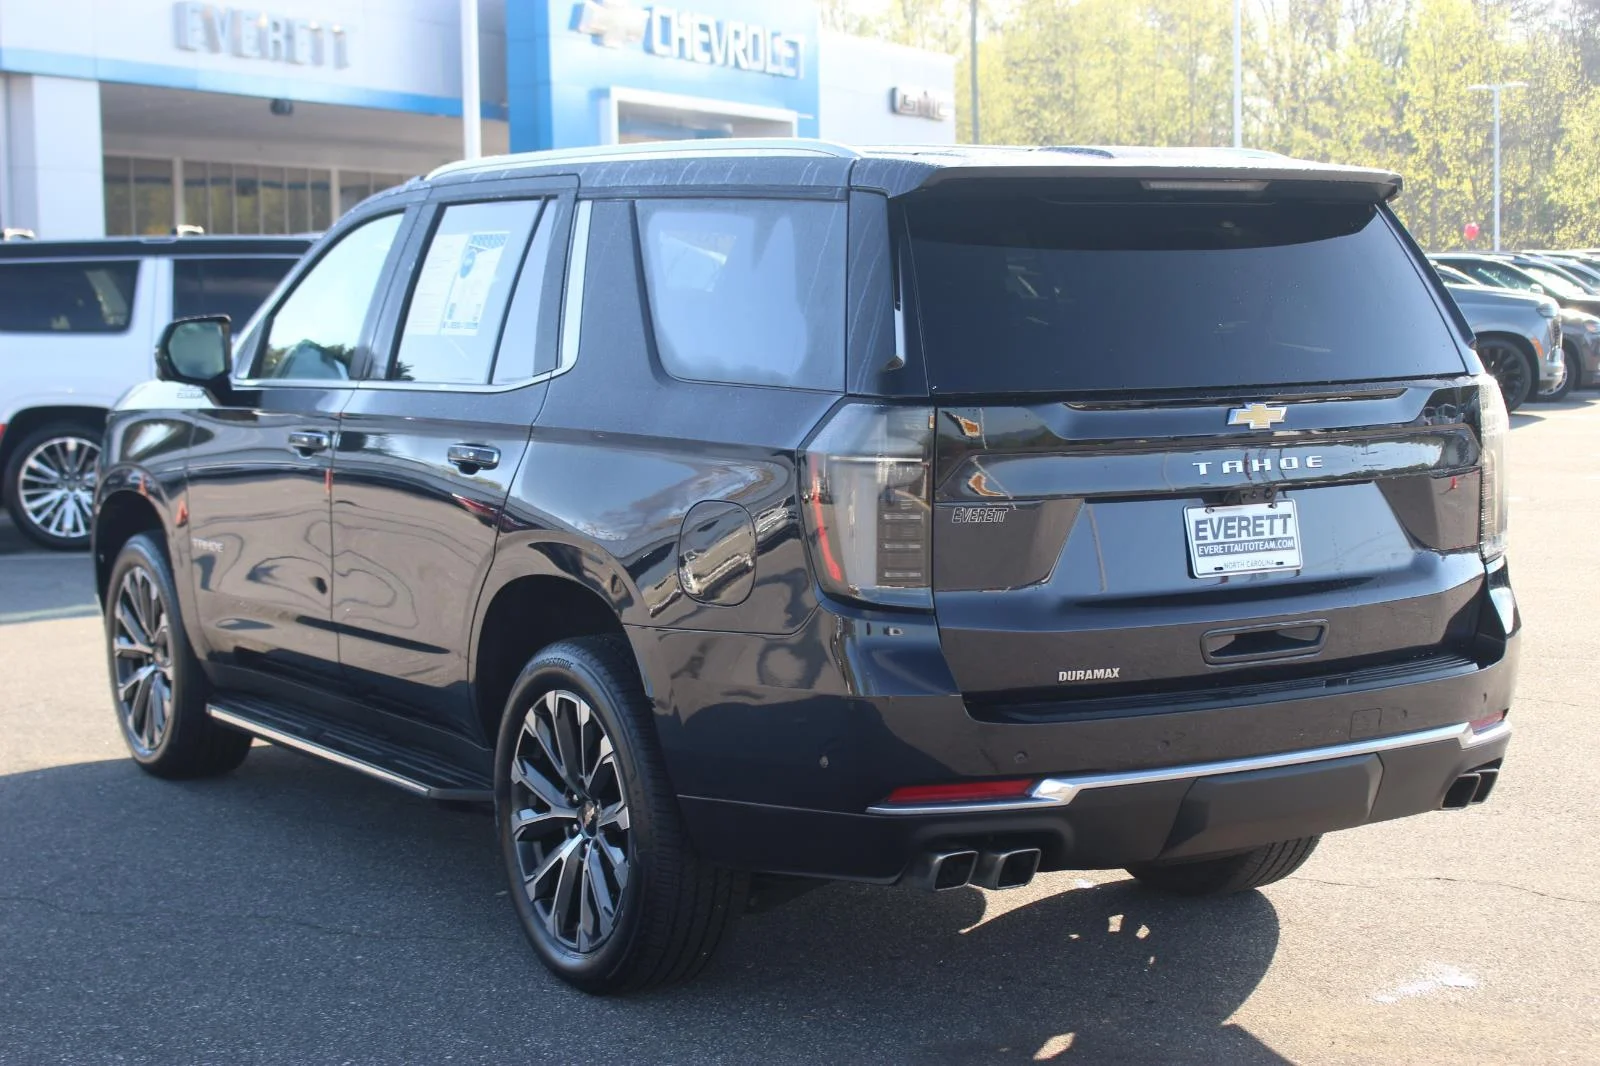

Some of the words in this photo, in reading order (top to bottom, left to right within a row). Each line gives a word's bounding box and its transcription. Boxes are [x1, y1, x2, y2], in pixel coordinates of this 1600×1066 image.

[173, 2, 350, 69] EVERETT
[645, 5, 806, 80] CHEVROLET
[1192, 455, 1324, 475] TAHOE
[952, 507, 1009, 523] EVERETT
[1194, 513, 1292, 541] EVERETT
[1198, 539, 1294, 555] EVERETTAUTOTEAM.COM
[1224, 561, 1246, 570] NORTH
[1247, 559, 1275, 568] CAROLINA
[1058, 667, 1120, 682] DURAMAX
